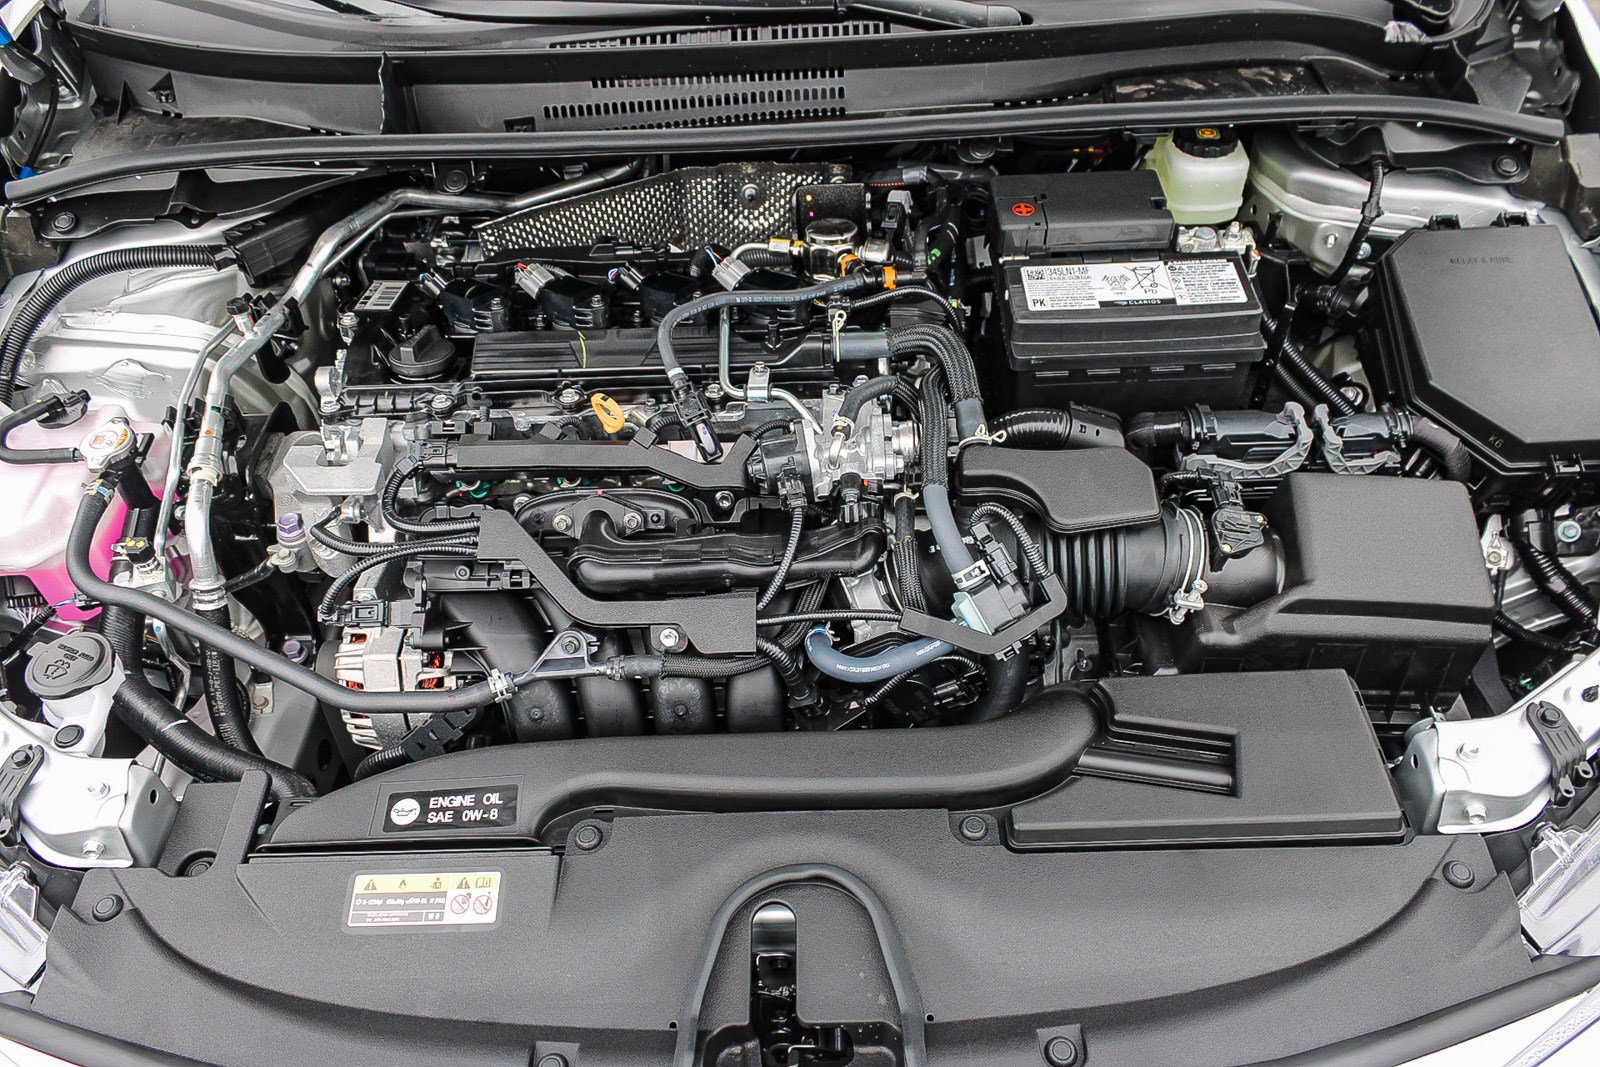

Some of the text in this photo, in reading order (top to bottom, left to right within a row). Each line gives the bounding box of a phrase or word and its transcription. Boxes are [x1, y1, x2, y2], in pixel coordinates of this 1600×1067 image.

[1046, 266, 1089, 277] 345LN1-MF
[1032, 298, 1047, 307] PK
[429, 792, 504, 809] ENGINE OIL
[426, 810, 455, 824] SAE
